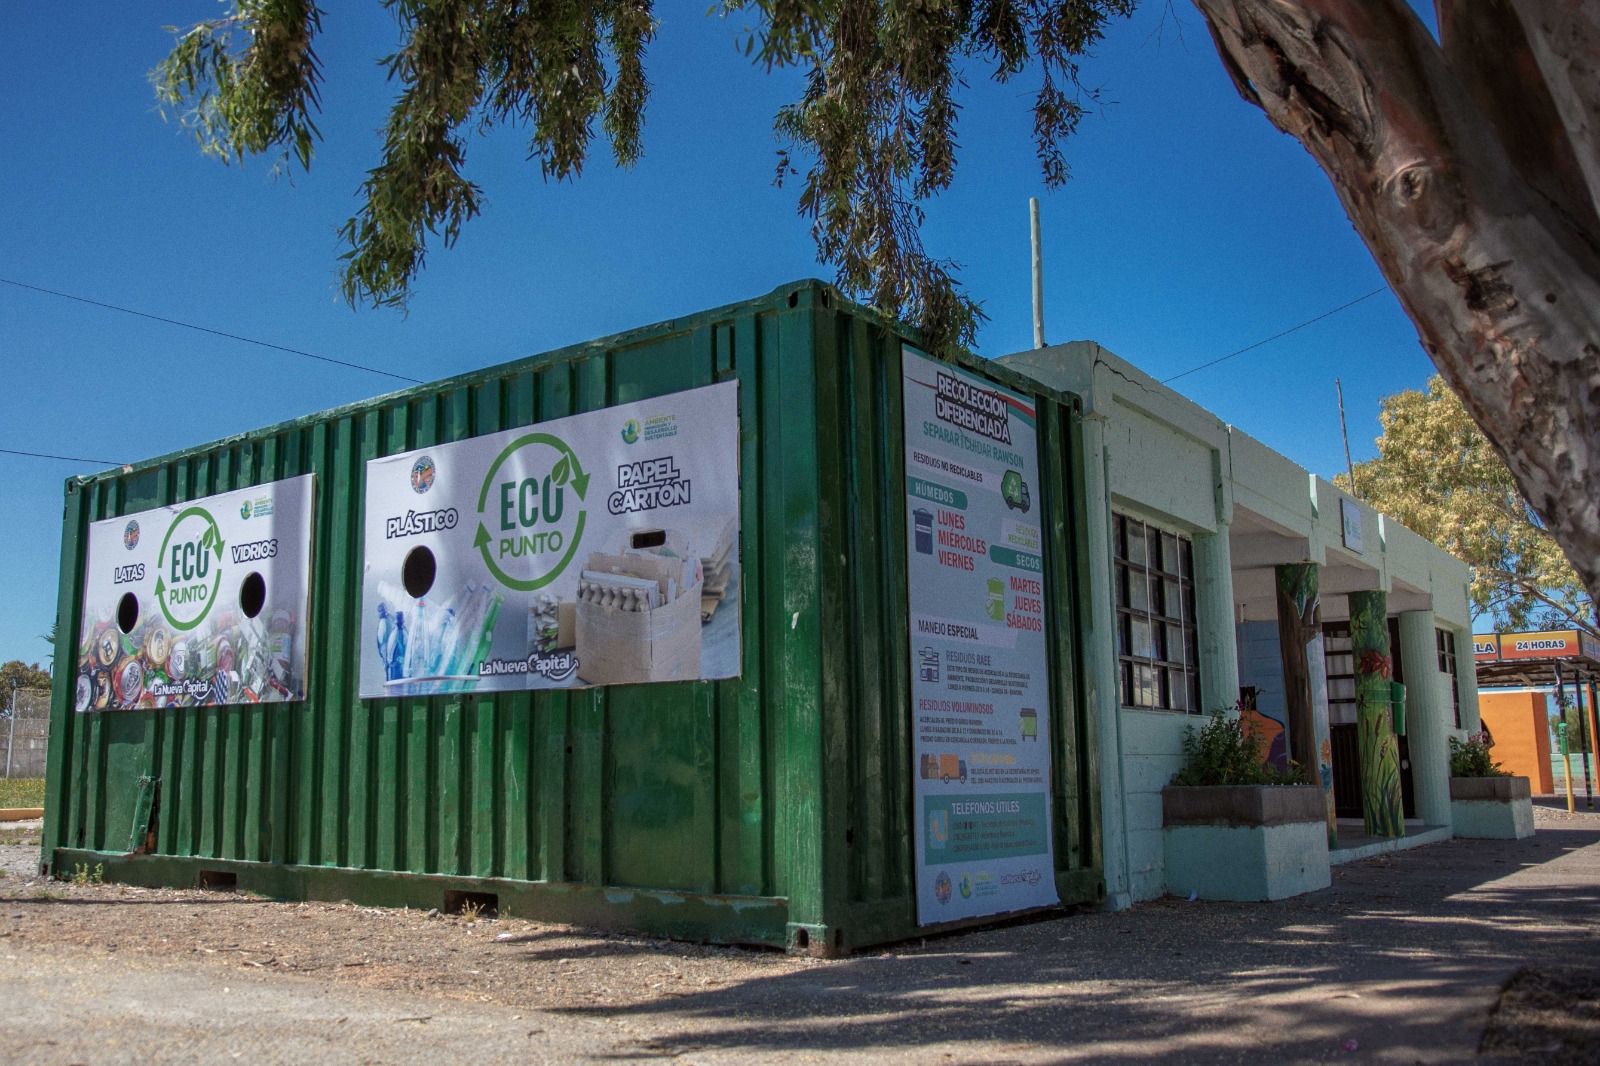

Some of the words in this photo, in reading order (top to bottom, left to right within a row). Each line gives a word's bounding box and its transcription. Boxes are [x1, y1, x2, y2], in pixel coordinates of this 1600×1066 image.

[937, 372, 1008, 421] RECOLECCIÓN
[935, 394, 1011, 445] DIFERENCIADA
[923, 421, 960, 447] SEPARAR
[993, 447, 1024, 469] RAWSON
[618, 456, 680, 488] PAPEL
[913, 451, 940, 469] RESIDUOS
[941, 461, 949, 472] NO
[949, 463, 983, 482] RECICLABLES
[500, 474, 564, 531] ECO
[607, 480, 690, 515] CARTÓN
[915, 481, 954, 504] HÚMEDOS
[386, 508, 458, 539] PLÁSTICO
[937, 509, 965, 531] LUNES
[231, 539, 278, 564] VIDRIOS
[499, 530, 563, 560] PUNTO
[938, 528, 986, 555] MIÉRCOLES
[171, 541, 209, 583] ECO
[938, 550, 974, 572] VIERNES
[1016, 554, 1040, 570] SECOS
[114, 563, 145, 583] LATAS
[169, 584, 207, 605] PUNTO
[1010, 576, 1040, 596] MARTES
[1014, 595, 1041, 614] JUEVES
[918, 620, 946, 635] MANEJO
[947, 624, 979, 640] ESPECIAL
[1006, 610, 1042, 632] SÁBADOS
[1473, 642, 1496, 654] LA
[1516, 641, 1529, 651] 24
[1531, 639, 1565, 650] HORAS
[492, 660, 528, 674] Nueva
[528, 653, 570, 675] Capital
[946, 650, 975, 664] RESIDUOS
[162, 684, 183, 695] Nueva
[183, 680, 208, 696] Capital
[919, 699, 951, 712] RESIDUOS
[951, 701, 994, 715] VOLUMINOSOS
[951, 799, 994, 815] TELÉFONOS
[996, 799, 1020, 813] ÚTILES
